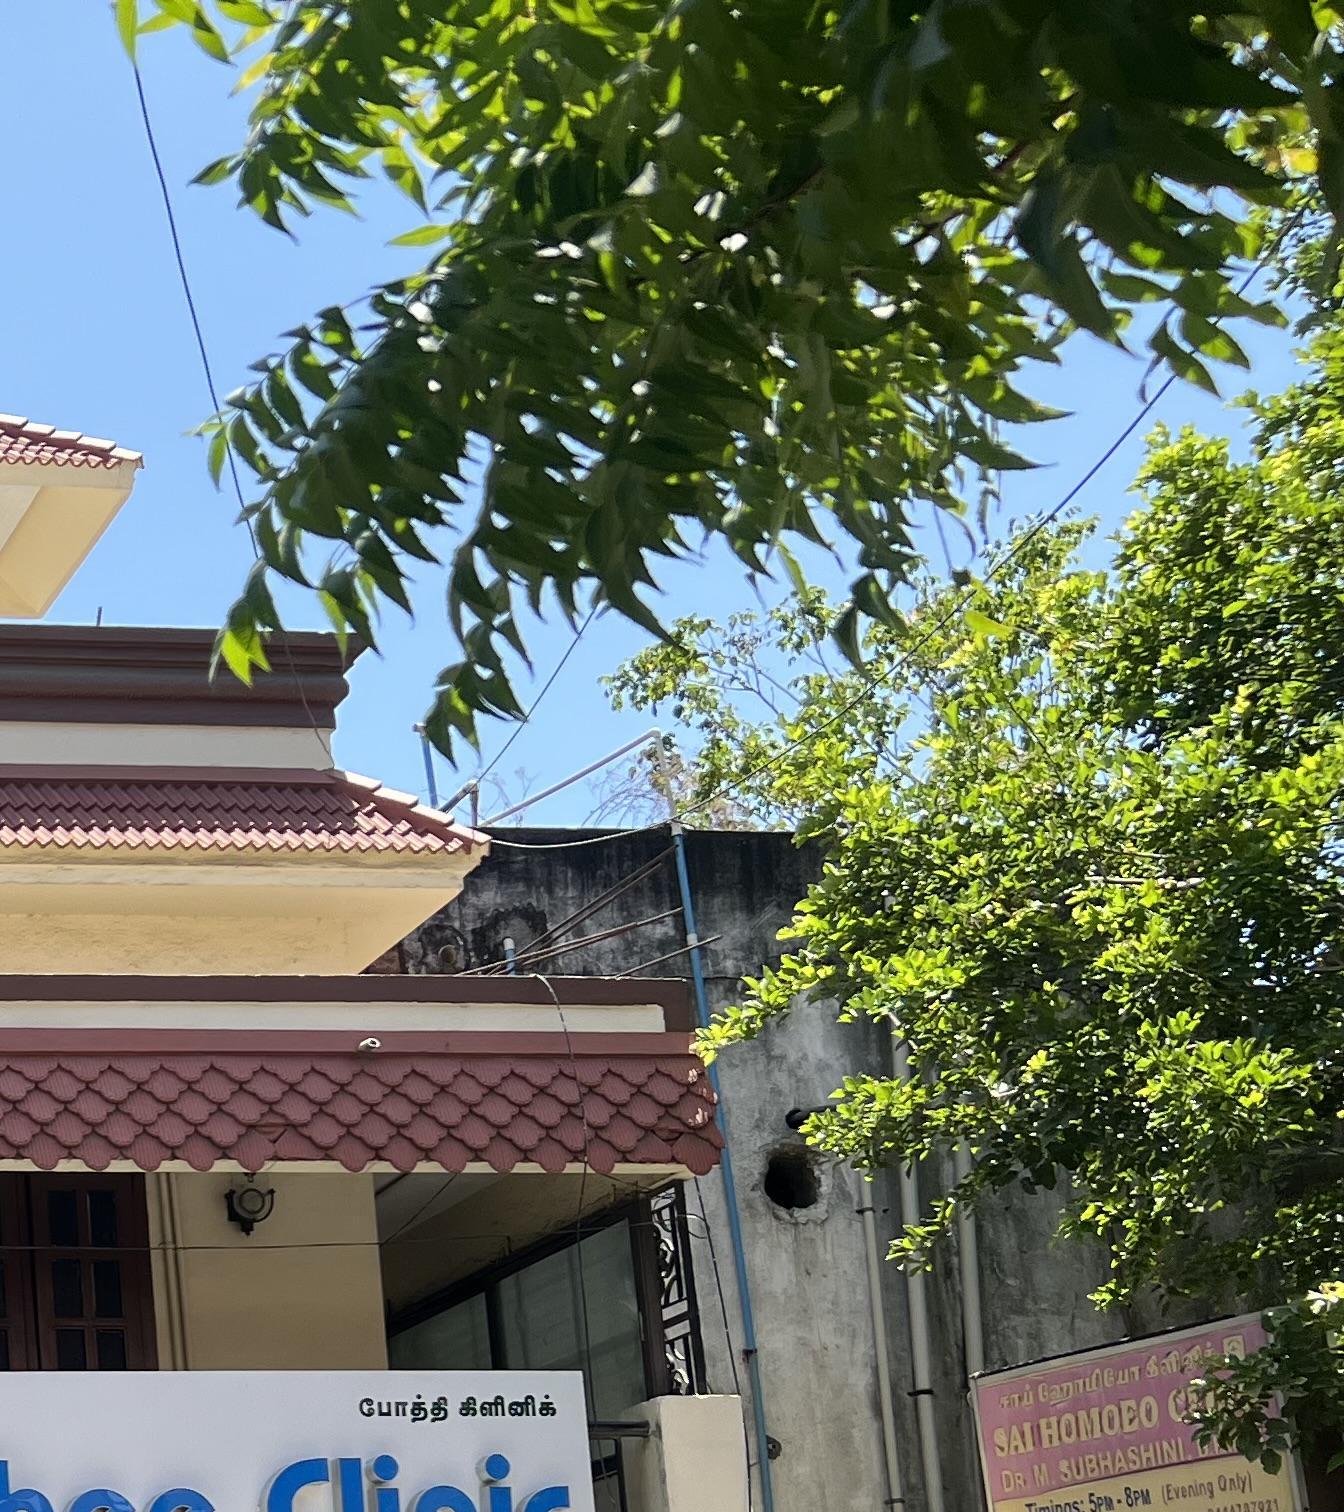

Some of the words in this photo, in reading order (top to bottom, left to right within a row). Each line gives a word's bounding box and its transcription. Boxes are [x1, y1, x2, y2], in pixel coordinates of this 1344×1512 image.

[359, 1394, 449, 1423] போத்தி
[458, 1394, 558, 1421] கிளினிக்
[993, 1422, 1034, 1457] SAI
[1039, 1395, 1159, 1449] HOMOEO
[1124, 1487, 1152, 1508] 8PM
